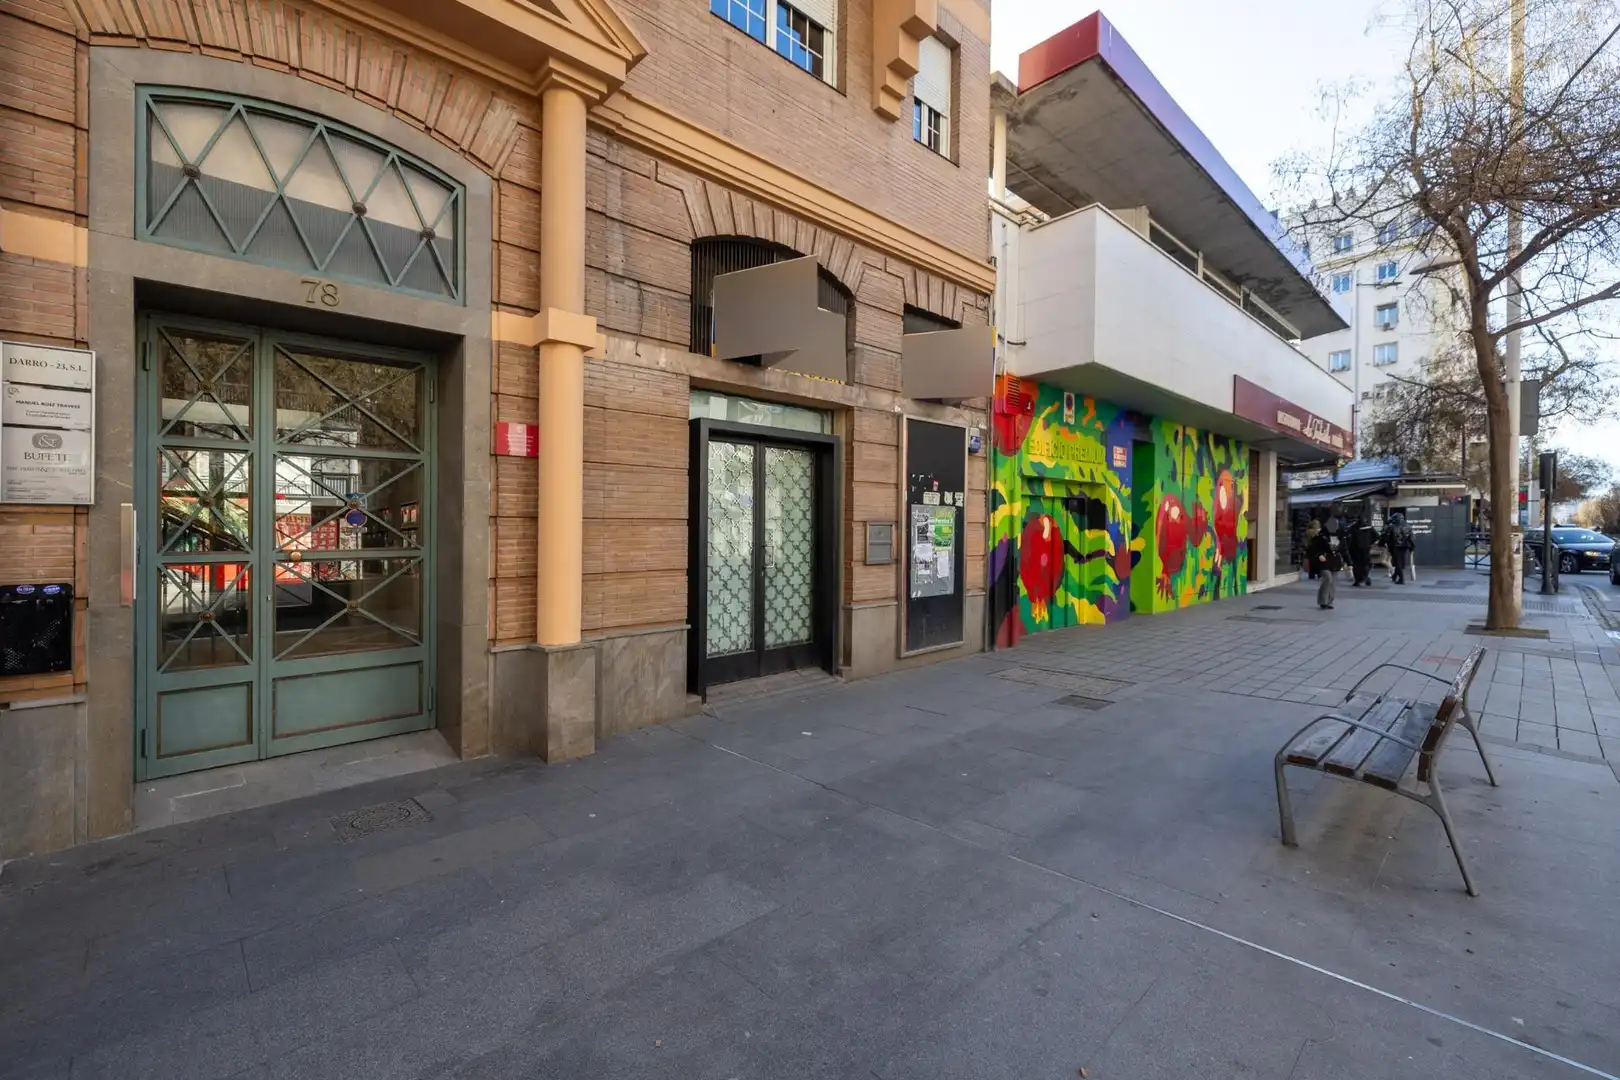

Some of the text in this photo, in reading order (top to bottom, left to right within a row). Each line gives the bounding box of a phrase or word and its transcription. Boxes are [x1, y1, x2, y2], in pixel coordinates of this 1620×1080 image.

[300, 280, 340, 307] 78
[9, 357, 48, 368] DARRO
[56, 362, 68, 371] 23,
